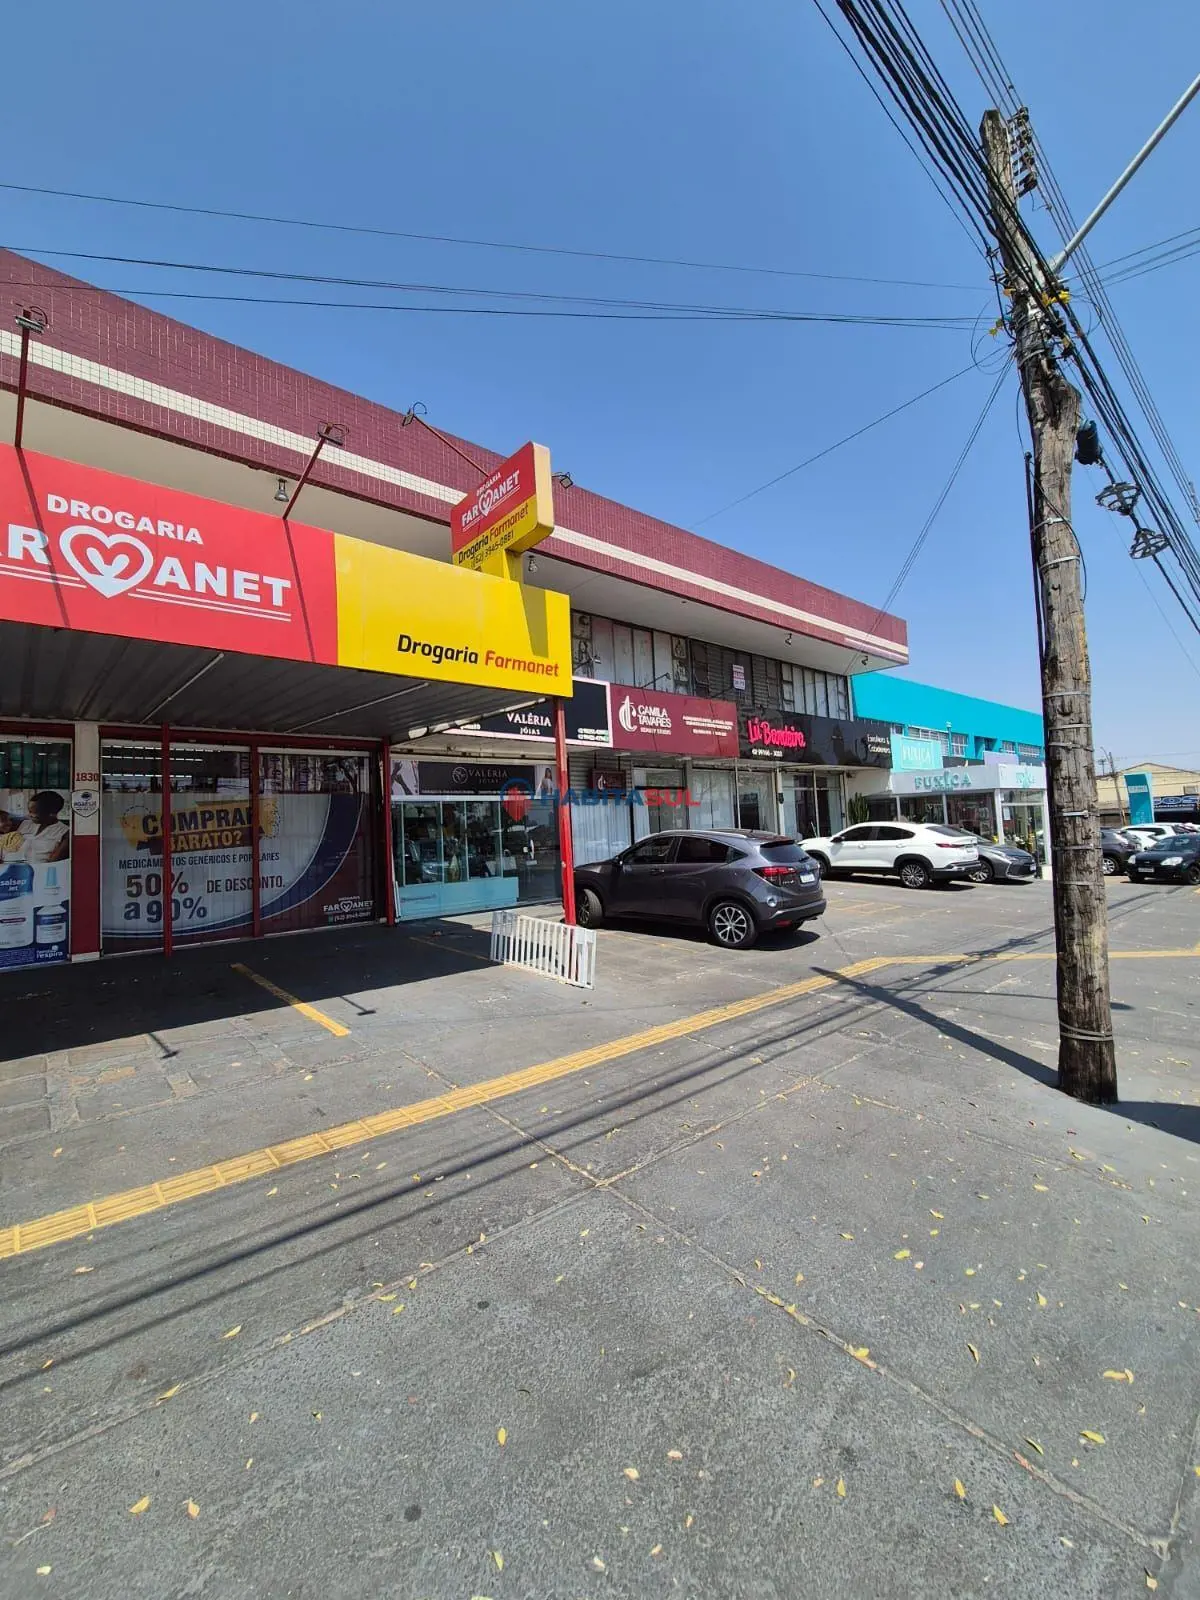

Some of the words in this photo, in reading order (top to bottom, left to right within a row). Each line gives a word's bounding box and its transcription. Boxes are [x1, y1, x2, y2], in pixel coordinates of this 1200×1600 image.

[47, 493, 204, 545] DROGARIA
[458, 534, 489, 564] Drogaria
[489, 502, 529, 541] Farmanet
[397, 633, 479, 664] Drogaria
[484, 649, 560, 677] Farmanet
[507, 711, 552, 727] VALÉRIA
[637, 704, 668, 719] CAMILA
[637, 714, 672, 728] TAVARES
[75, 772, 99, 782] 1830
[232, 854, 238, 864] E
[206, 880, 222, 895] DE
[123, 901, 142, 920] a
